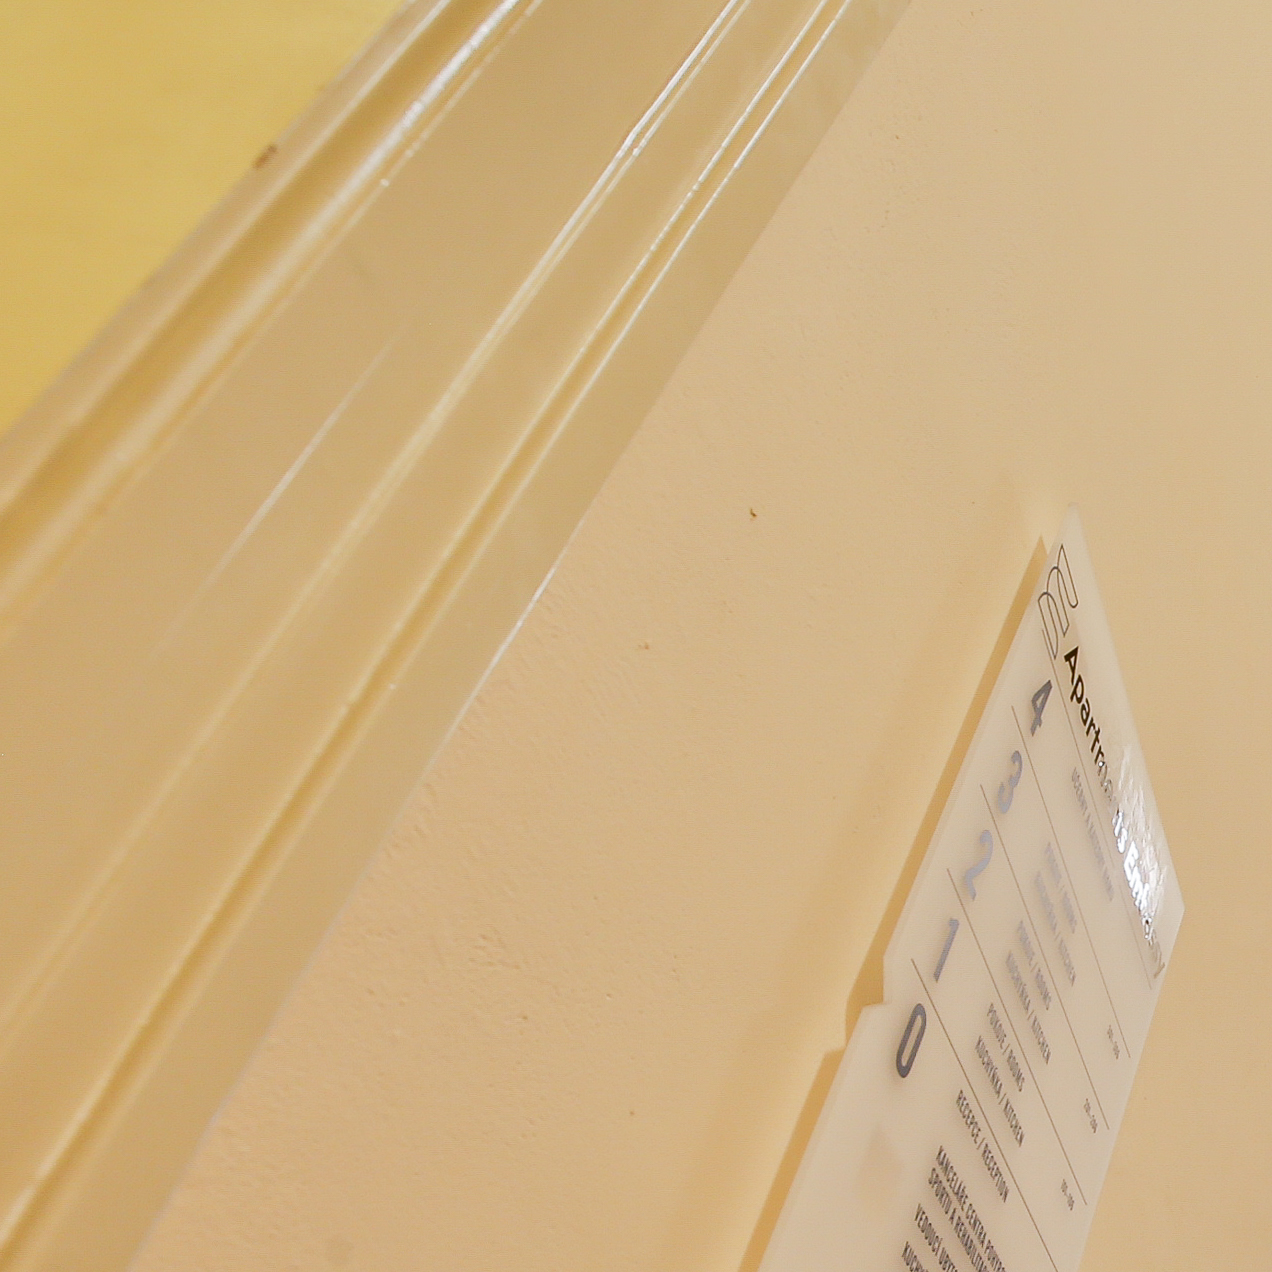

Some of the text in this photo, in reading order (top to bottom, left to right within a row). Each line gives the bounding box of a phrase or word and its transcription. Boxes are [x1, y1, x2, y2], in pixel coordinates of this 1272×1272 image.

[1029, 678, 1053, 737] 4
[998, 749, 1024, 813] 3
[962, 828, 995, 901] 2
[933, 917, 960, 983] 1
[895, 1001, 928, 1080] 0
[986, 1003, 1006, 1049] POKOJE
[1006, 1049, 1024, 1092] ROOMS
[1031, 1015, 1051, 1064] KITCHEN
[974, 1033, 1003, 1099] KUCHYŇKA
[1003, 1099, 1024, 1147] KITCHEN
[955, 1091, 980, 1144] RECEPCE
[981, 1144, 1008, 1203] RECEPTION
[913, 1203, 942, 1258] VEDOUCÍ
[927, 1168, 951, 1216] SPORTU
[948, 1206, 956, 1225] A
[935, 1145, 968, 1211] KANCELÁŘE
[965, 1203, 986, 1247] CENTRA
